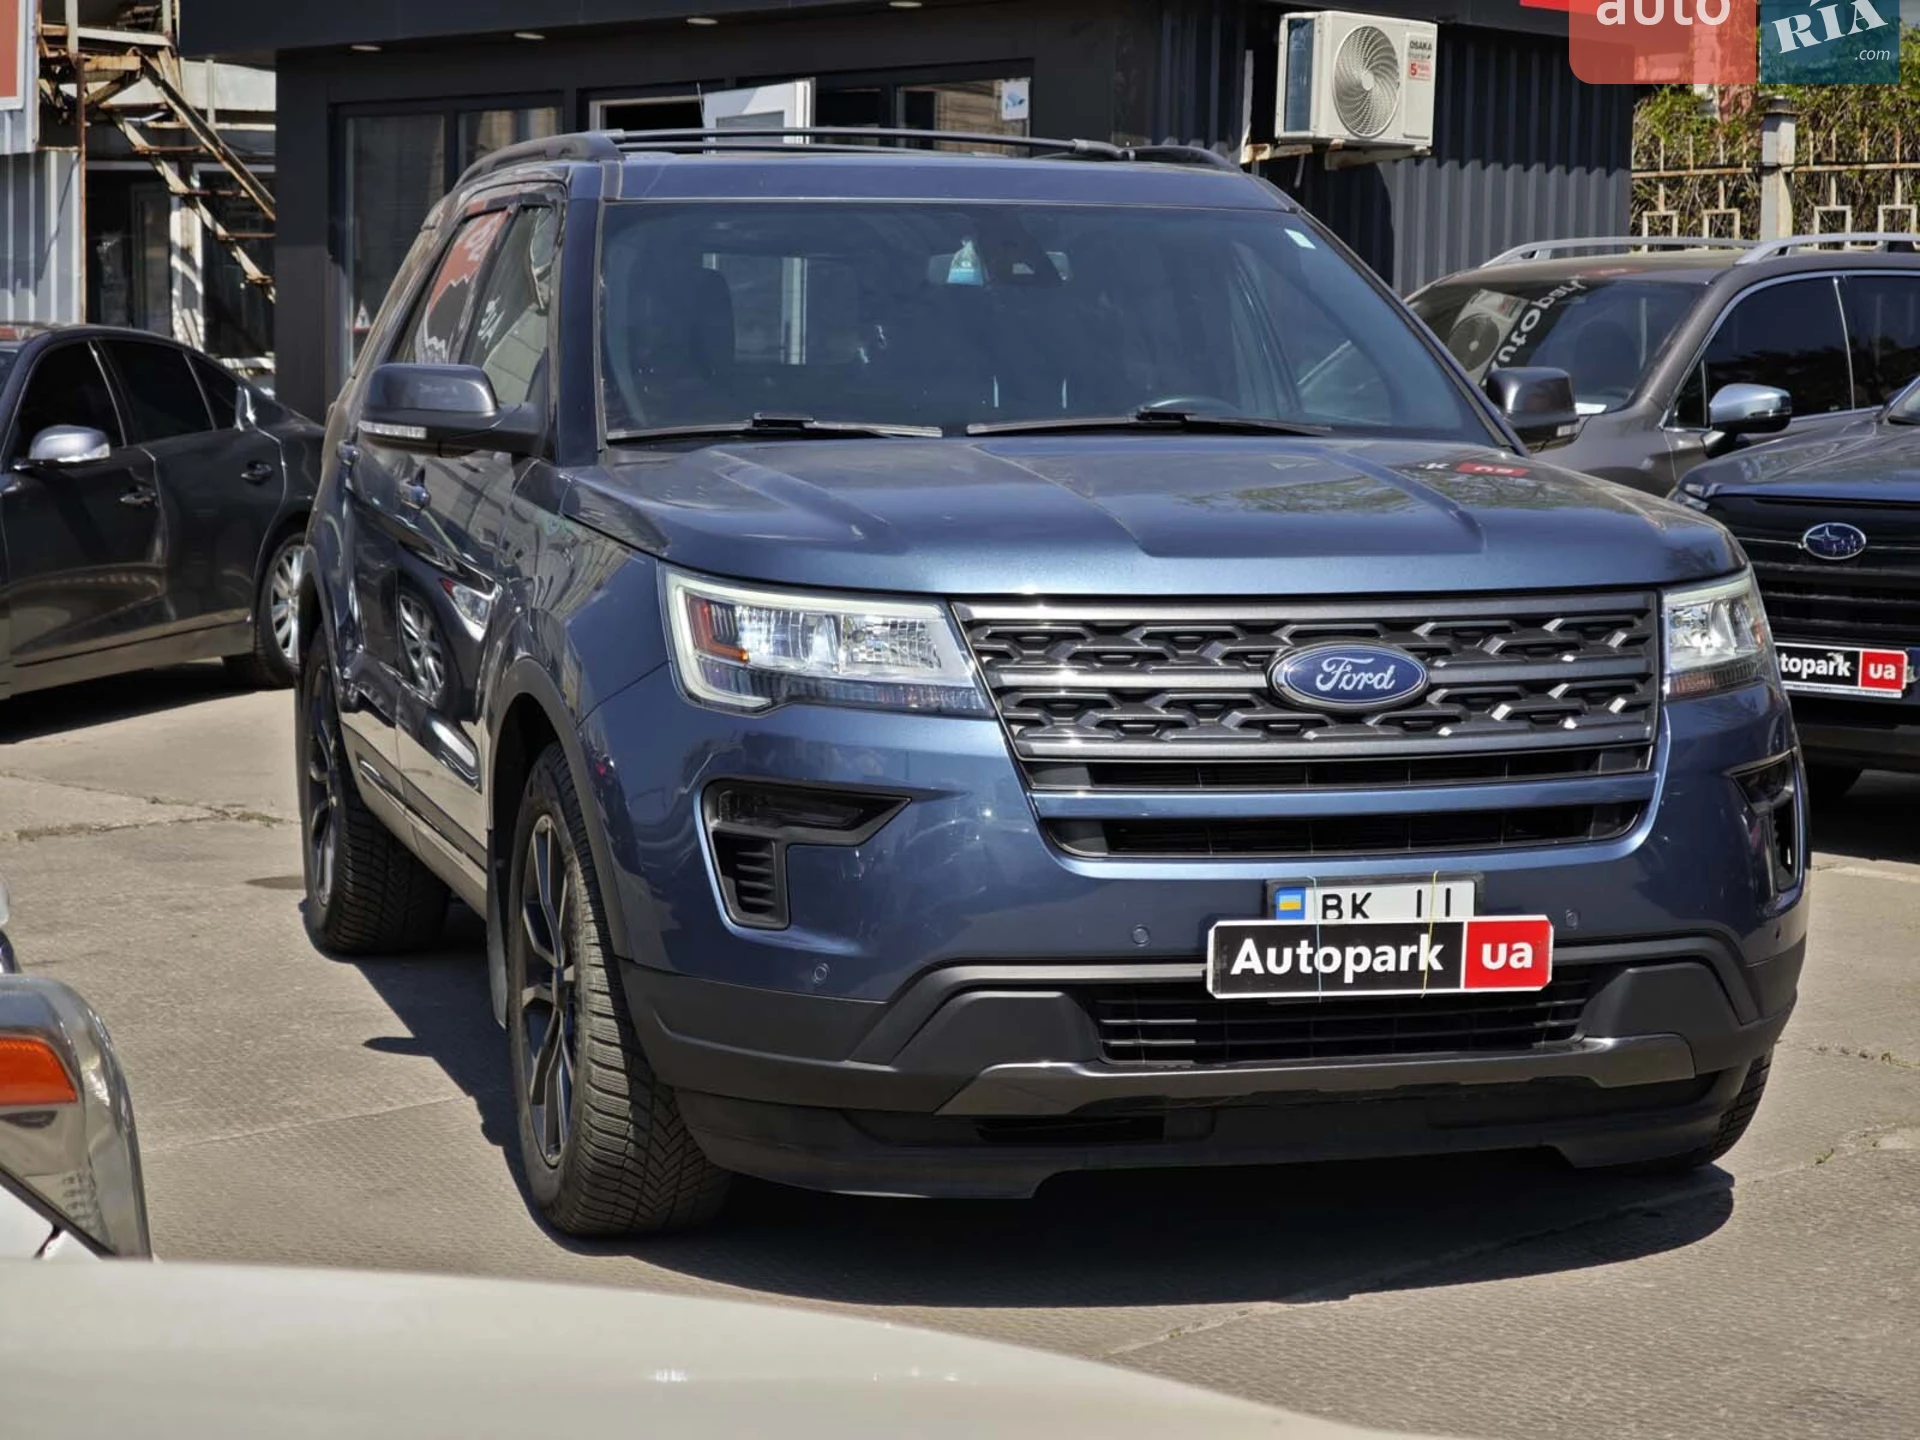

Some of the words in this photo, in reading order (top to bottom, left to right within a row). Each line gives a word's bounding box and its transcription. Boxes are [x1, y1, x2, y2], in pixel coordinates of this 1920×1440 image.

[1316, 657, 1396, 691] Ford
[1780, 652, 1851, 679] topark
[1868, 663, 1896, 680] ua
[1230, 933, 1443, 984] Autopark
[1481, 941, 1533, 970] ua
